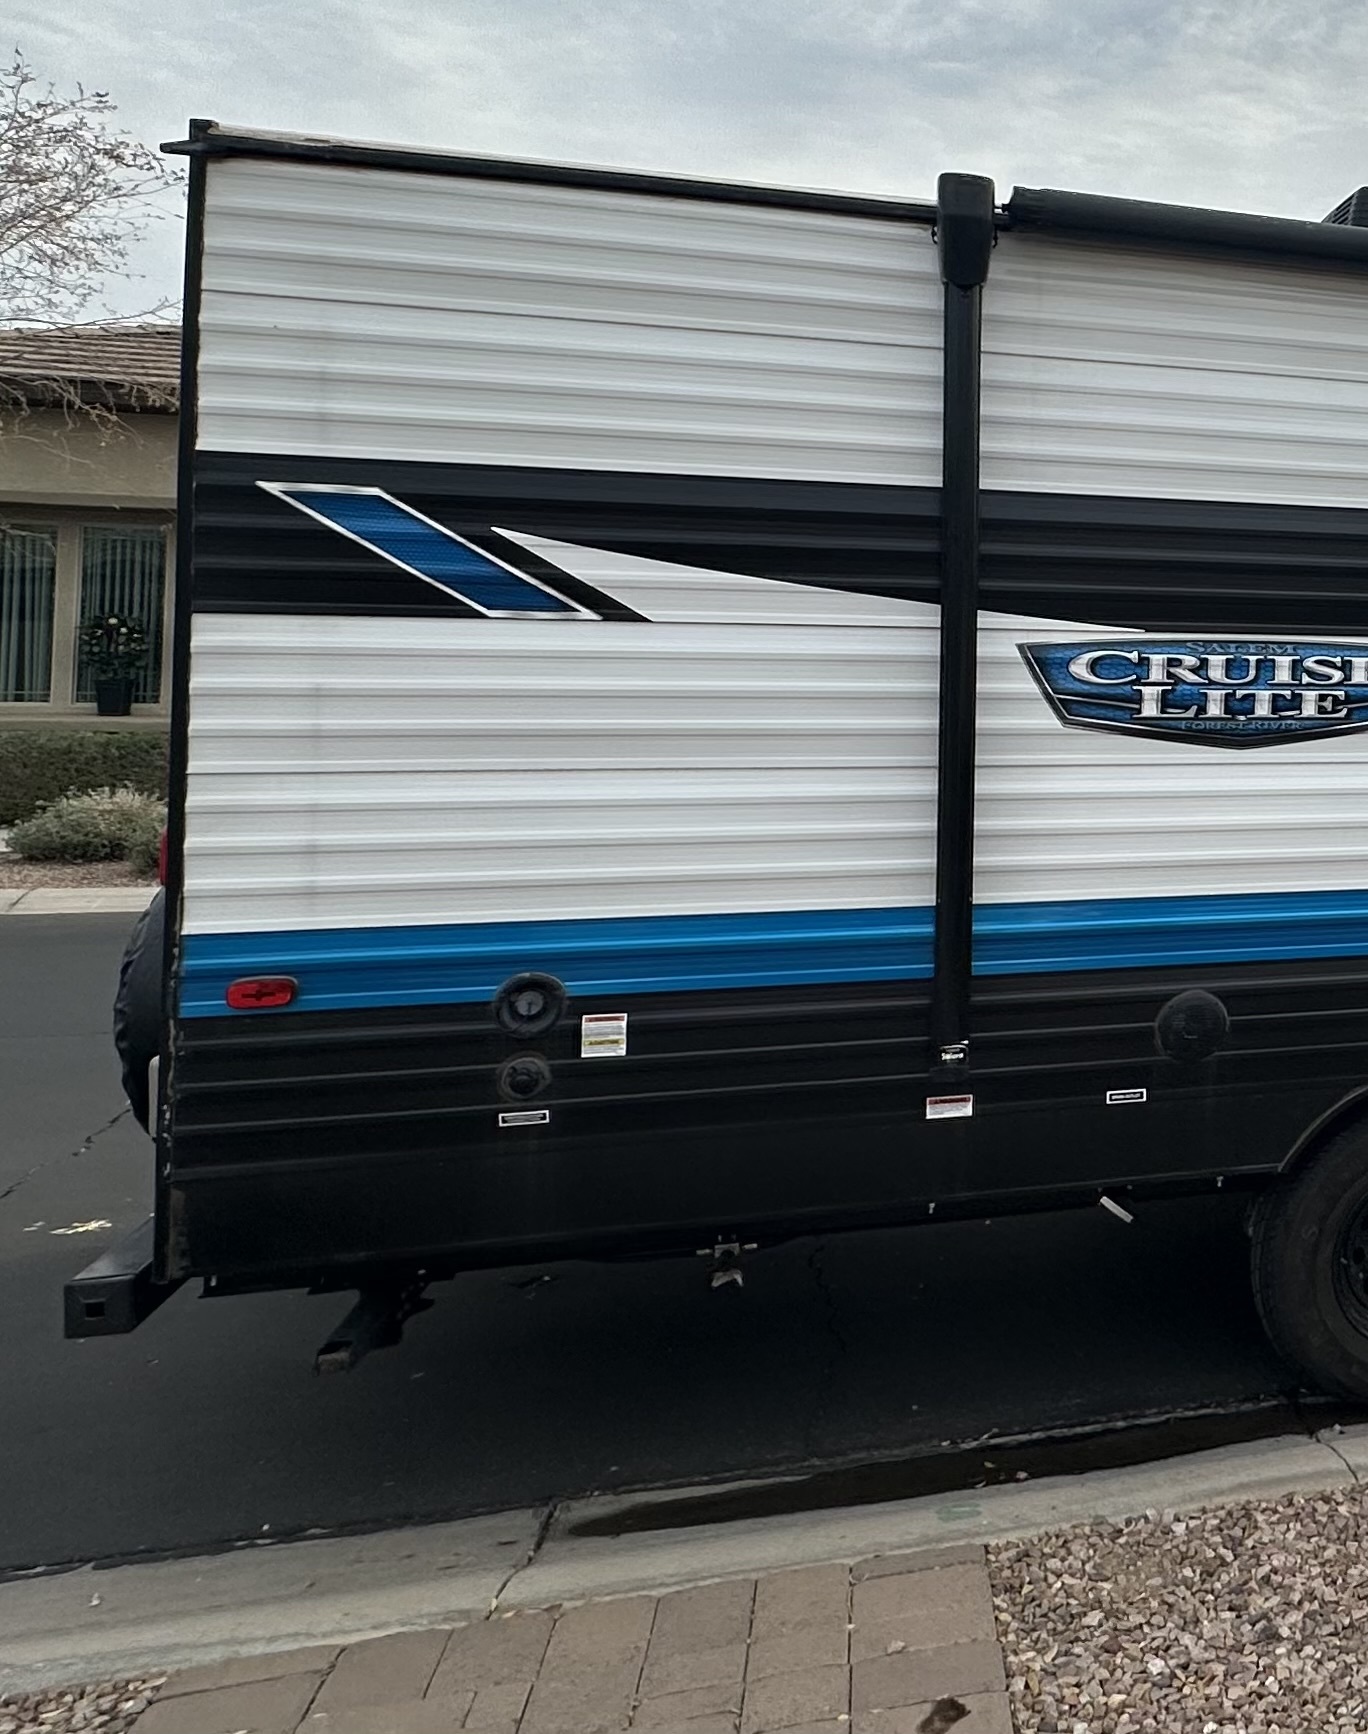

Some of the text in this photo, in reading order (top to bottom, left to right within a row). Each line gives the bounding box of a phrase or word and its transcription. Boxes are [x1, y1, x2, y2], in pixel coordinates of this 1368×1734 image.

[1185, 641, 1298, 654] SALEM
[1131, 685, 1350, 719] LITE
[1181, 720, 1303, 730] FOREST RIVER
